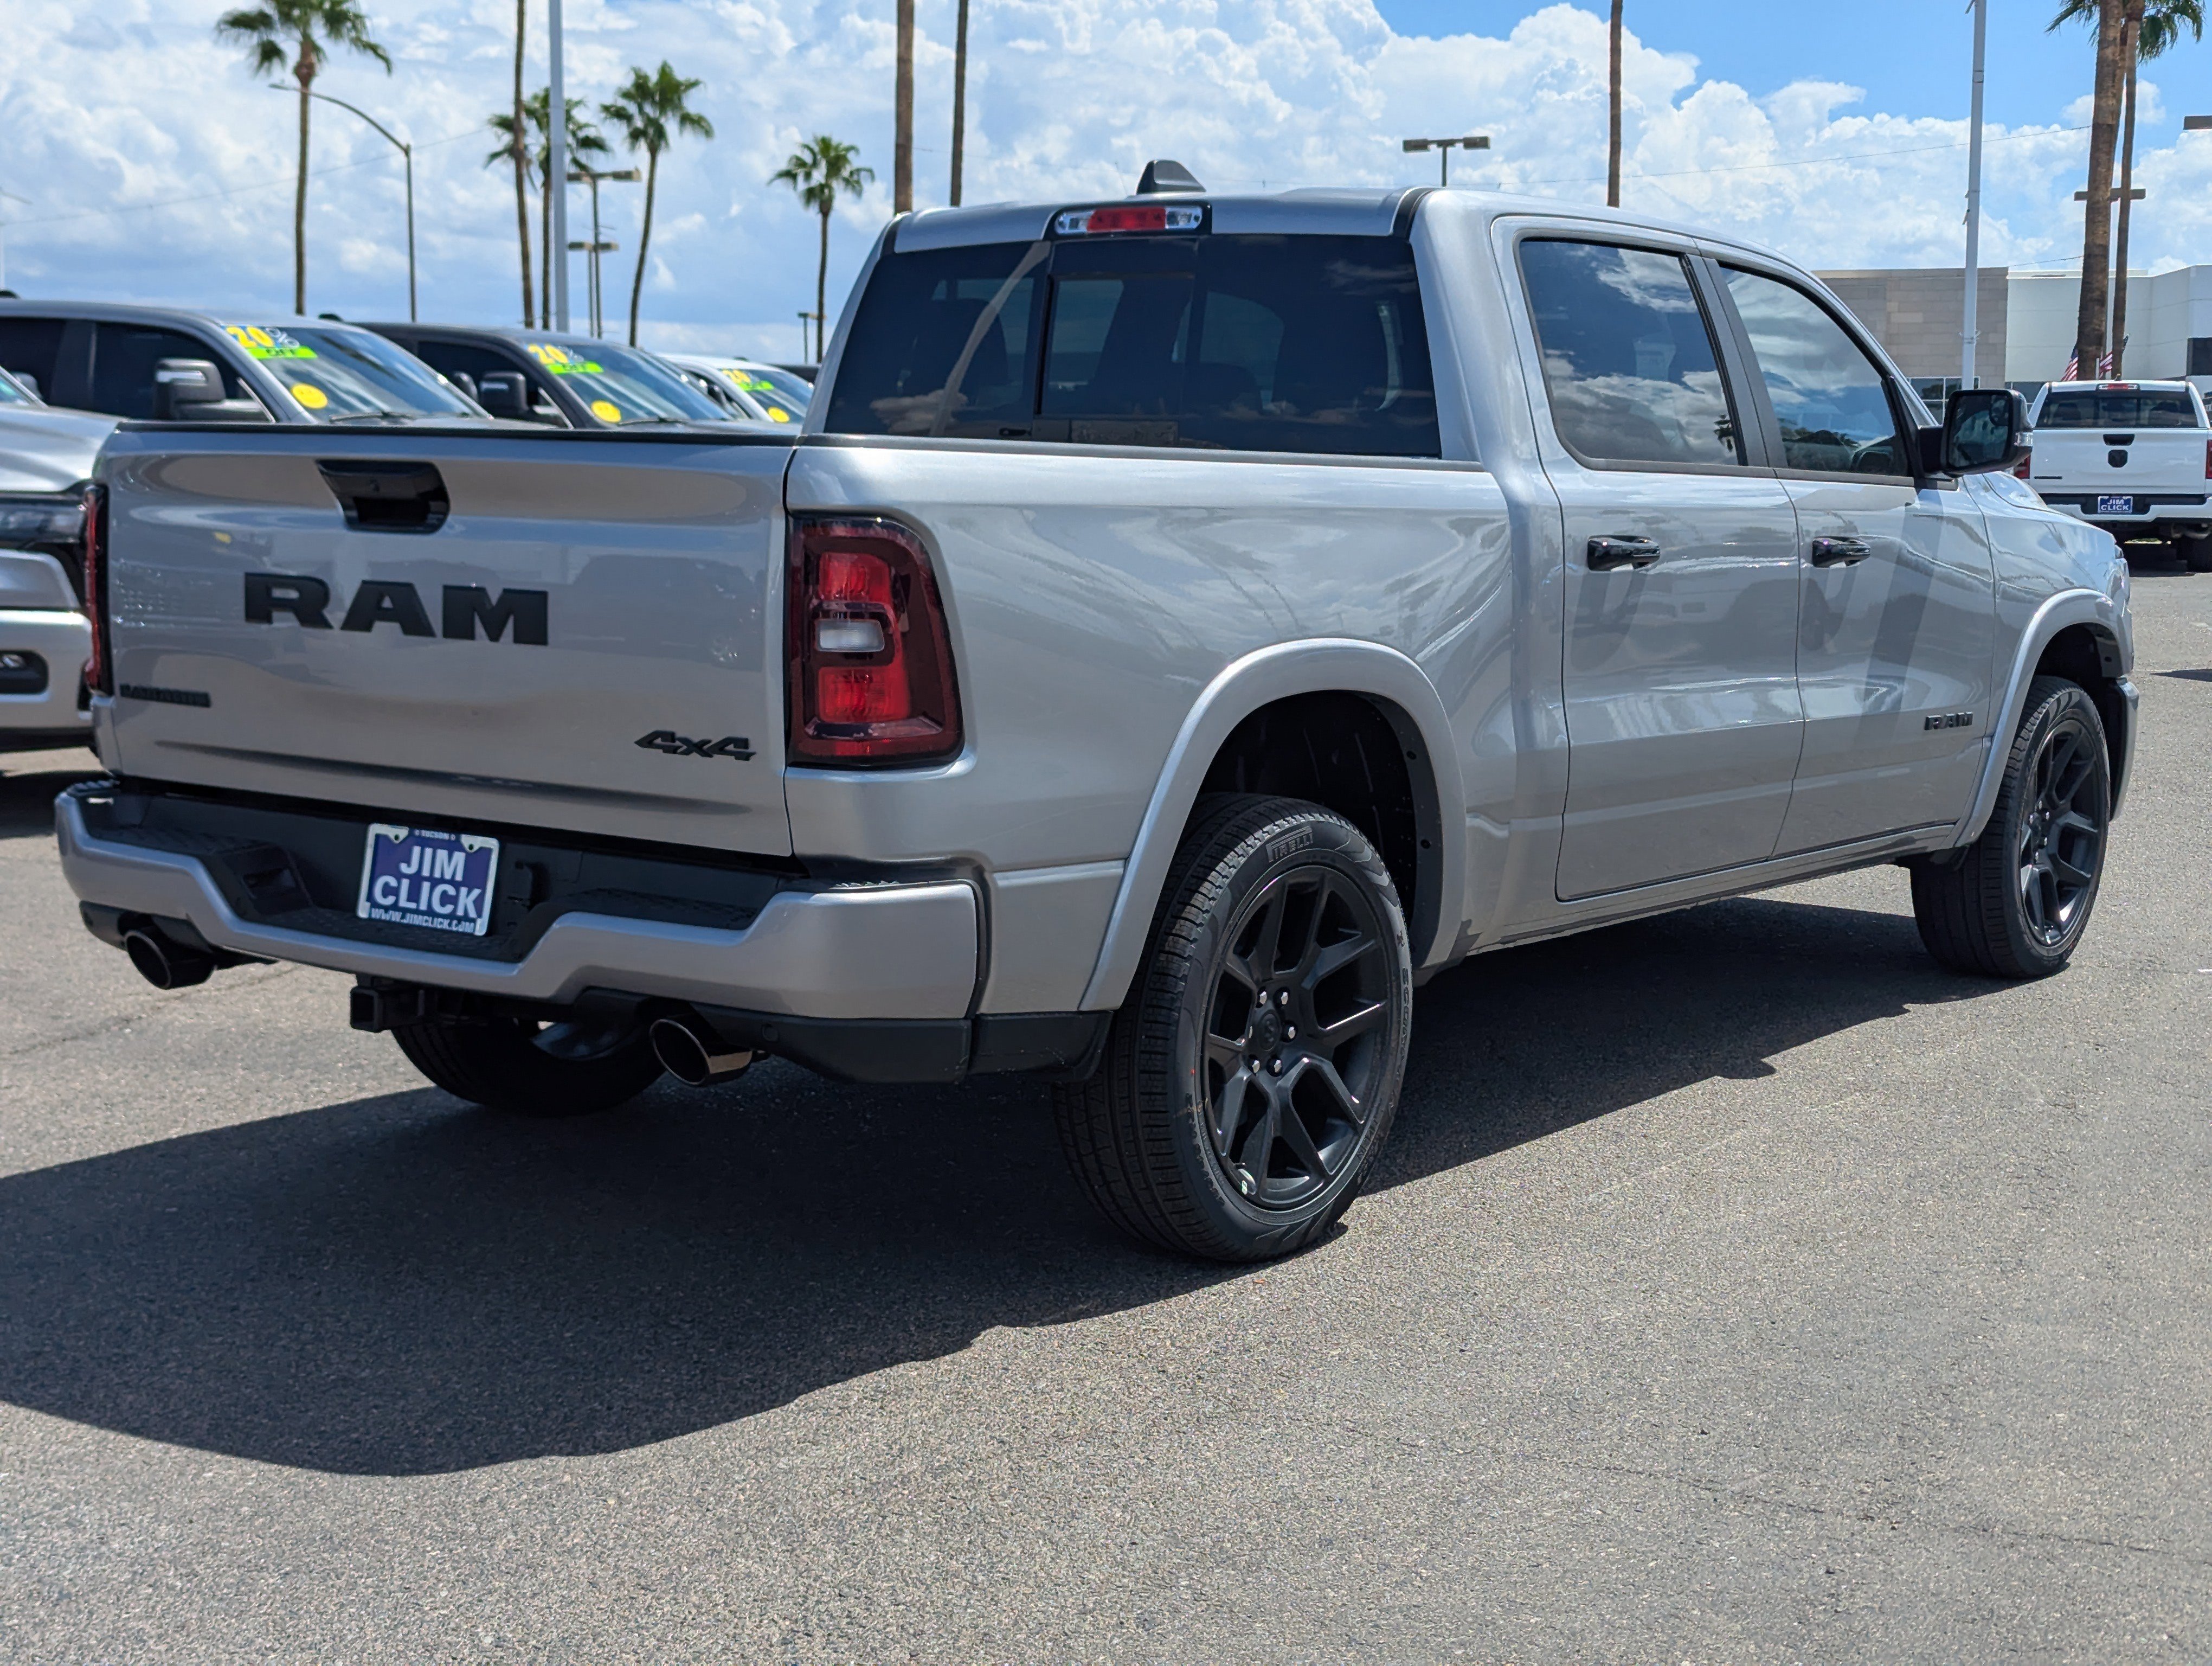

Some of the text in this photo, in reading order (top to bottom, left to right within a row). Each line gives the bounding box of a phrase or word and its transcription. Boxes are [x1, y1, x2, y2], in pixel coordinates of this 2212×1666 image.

[245, 572, 549, 646] RAM
[1924, 712, 1973, 731] RAM
[634, 729, 756, 761] 4x4
[1266, 825, 1314, 863] PIRELLI
[399, 845, 466, 881] JIM
[373, 875, 482, 918] CLICK
